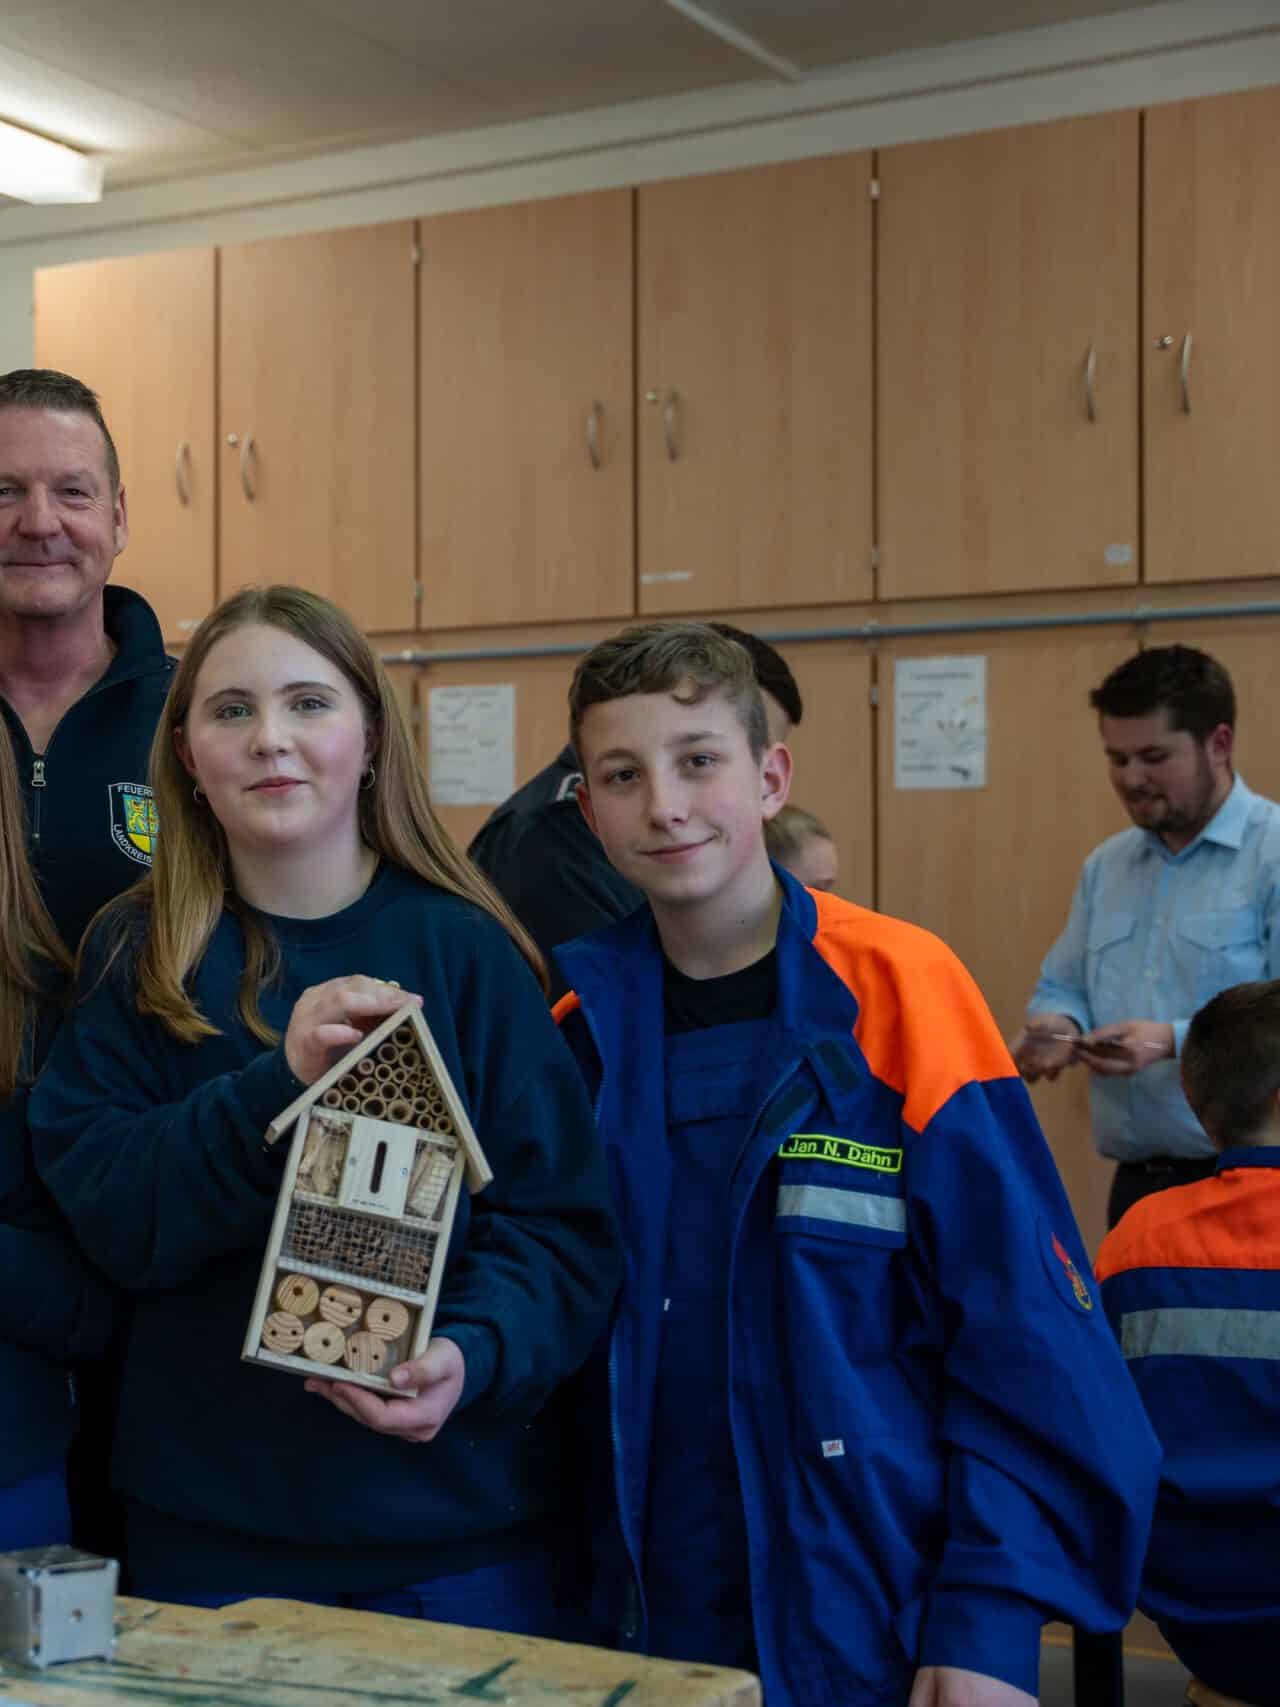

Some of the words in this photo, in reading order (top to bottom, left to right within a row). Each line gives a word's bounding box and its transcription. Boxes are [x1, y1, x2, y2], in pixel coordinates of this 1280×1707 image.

[117, 784, 153, 799] FEUER
[788, 1138, 818, 1153] Jan
[823, 1140, 841, 1157] N.
